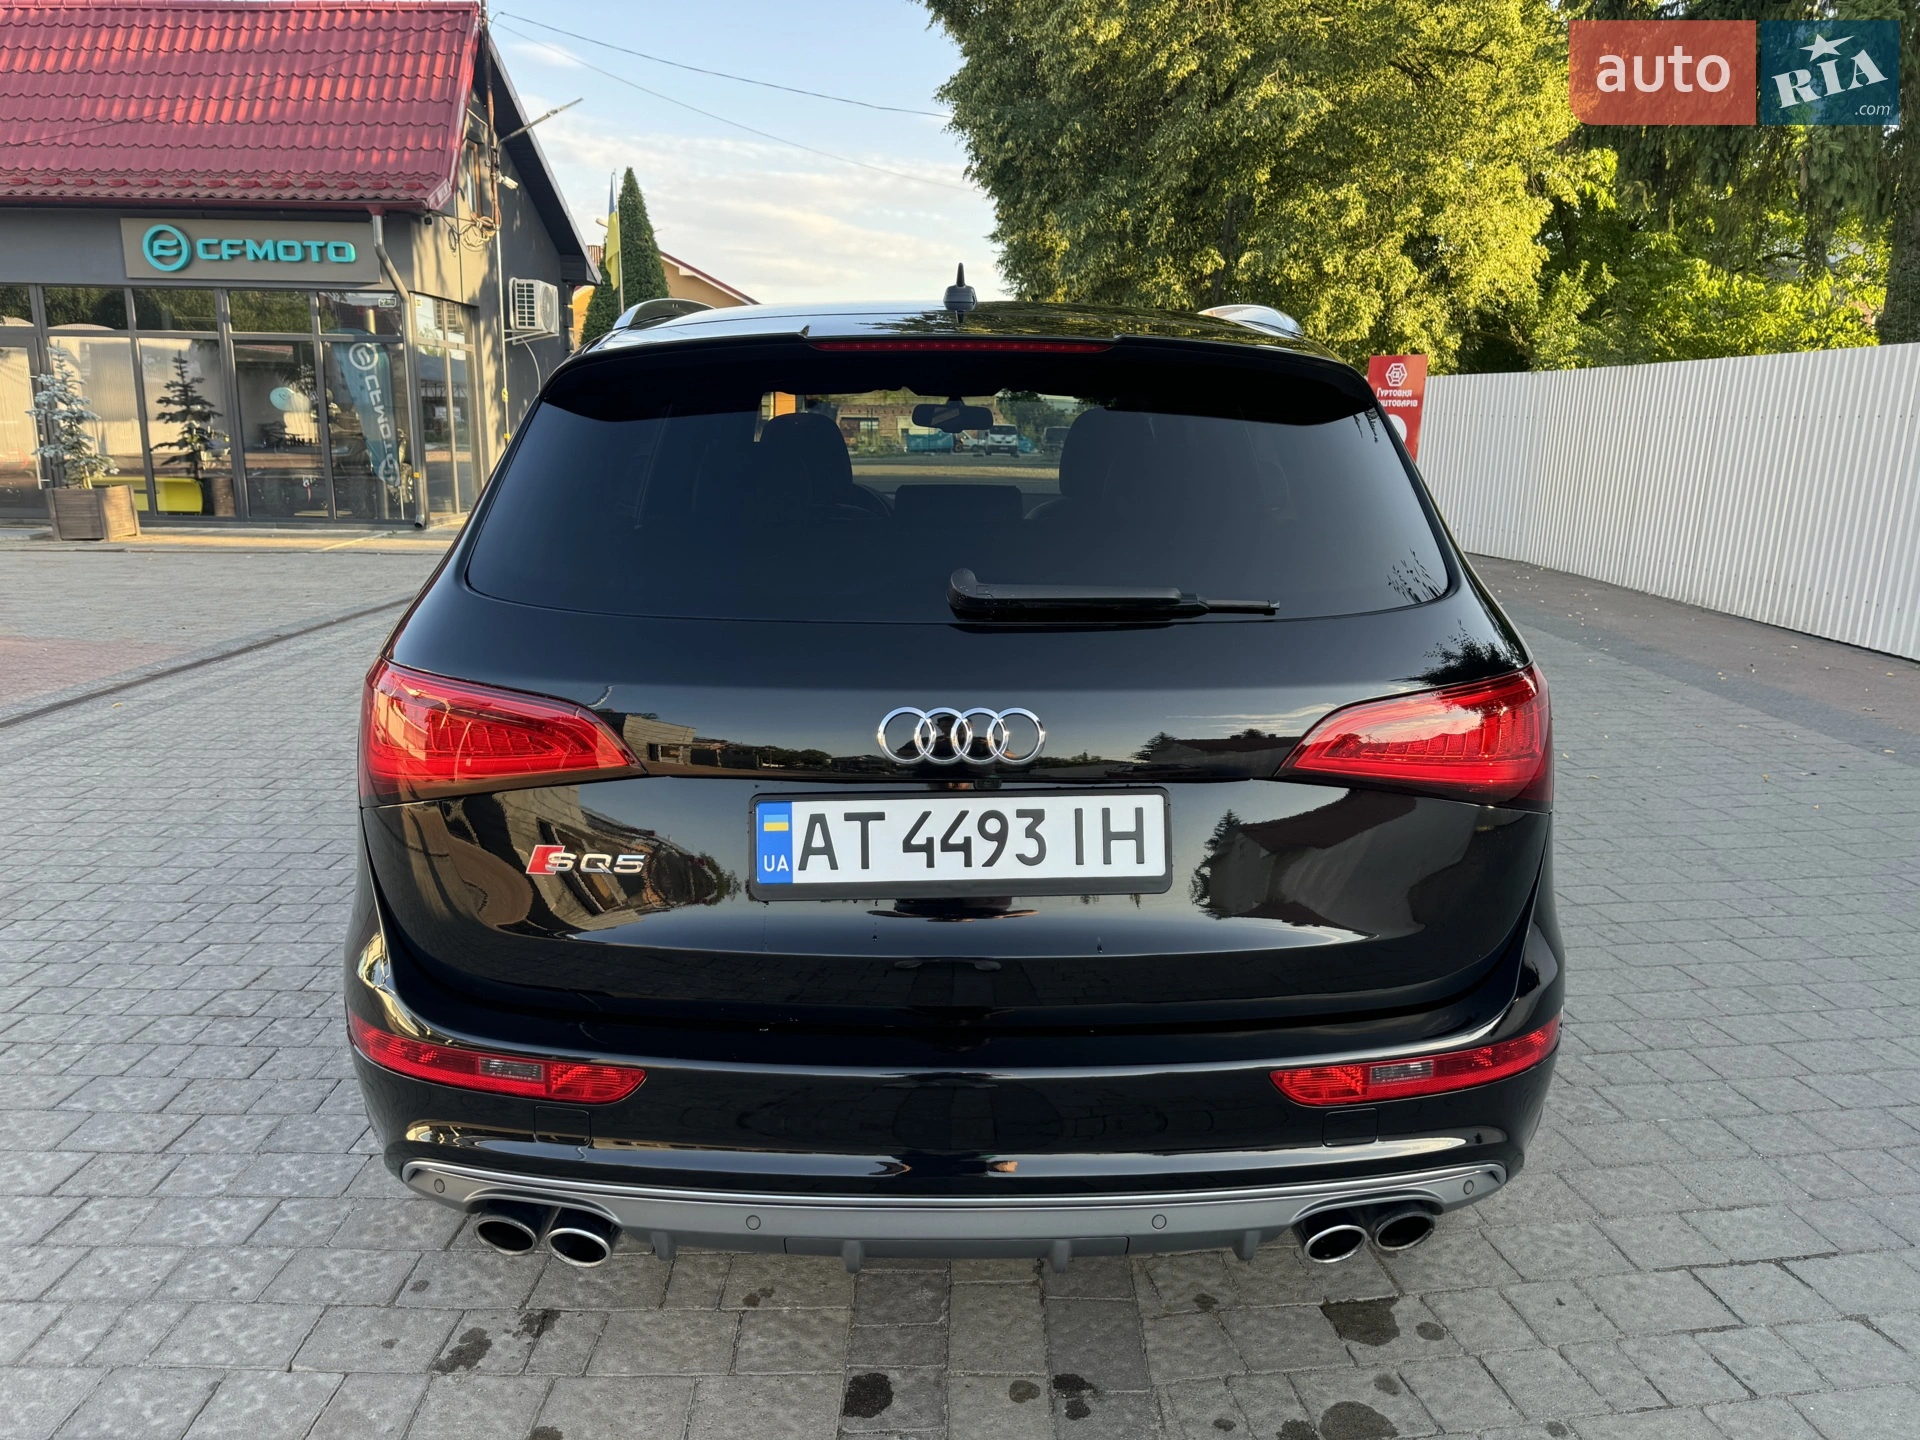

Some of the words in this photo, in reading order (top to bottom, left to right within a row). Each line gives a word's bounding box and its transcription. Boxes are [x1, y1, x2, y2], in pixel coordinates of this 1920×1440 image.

[196, 238, 356, 263] CFMOTO
[798, 811, 885, 871] AT
[902, 808, 1047, 869] 4493
[1073, 806, 1145, 866] IH
[545, 852, 646, 875] SQ5
[763, 854, 789, 873] UA
